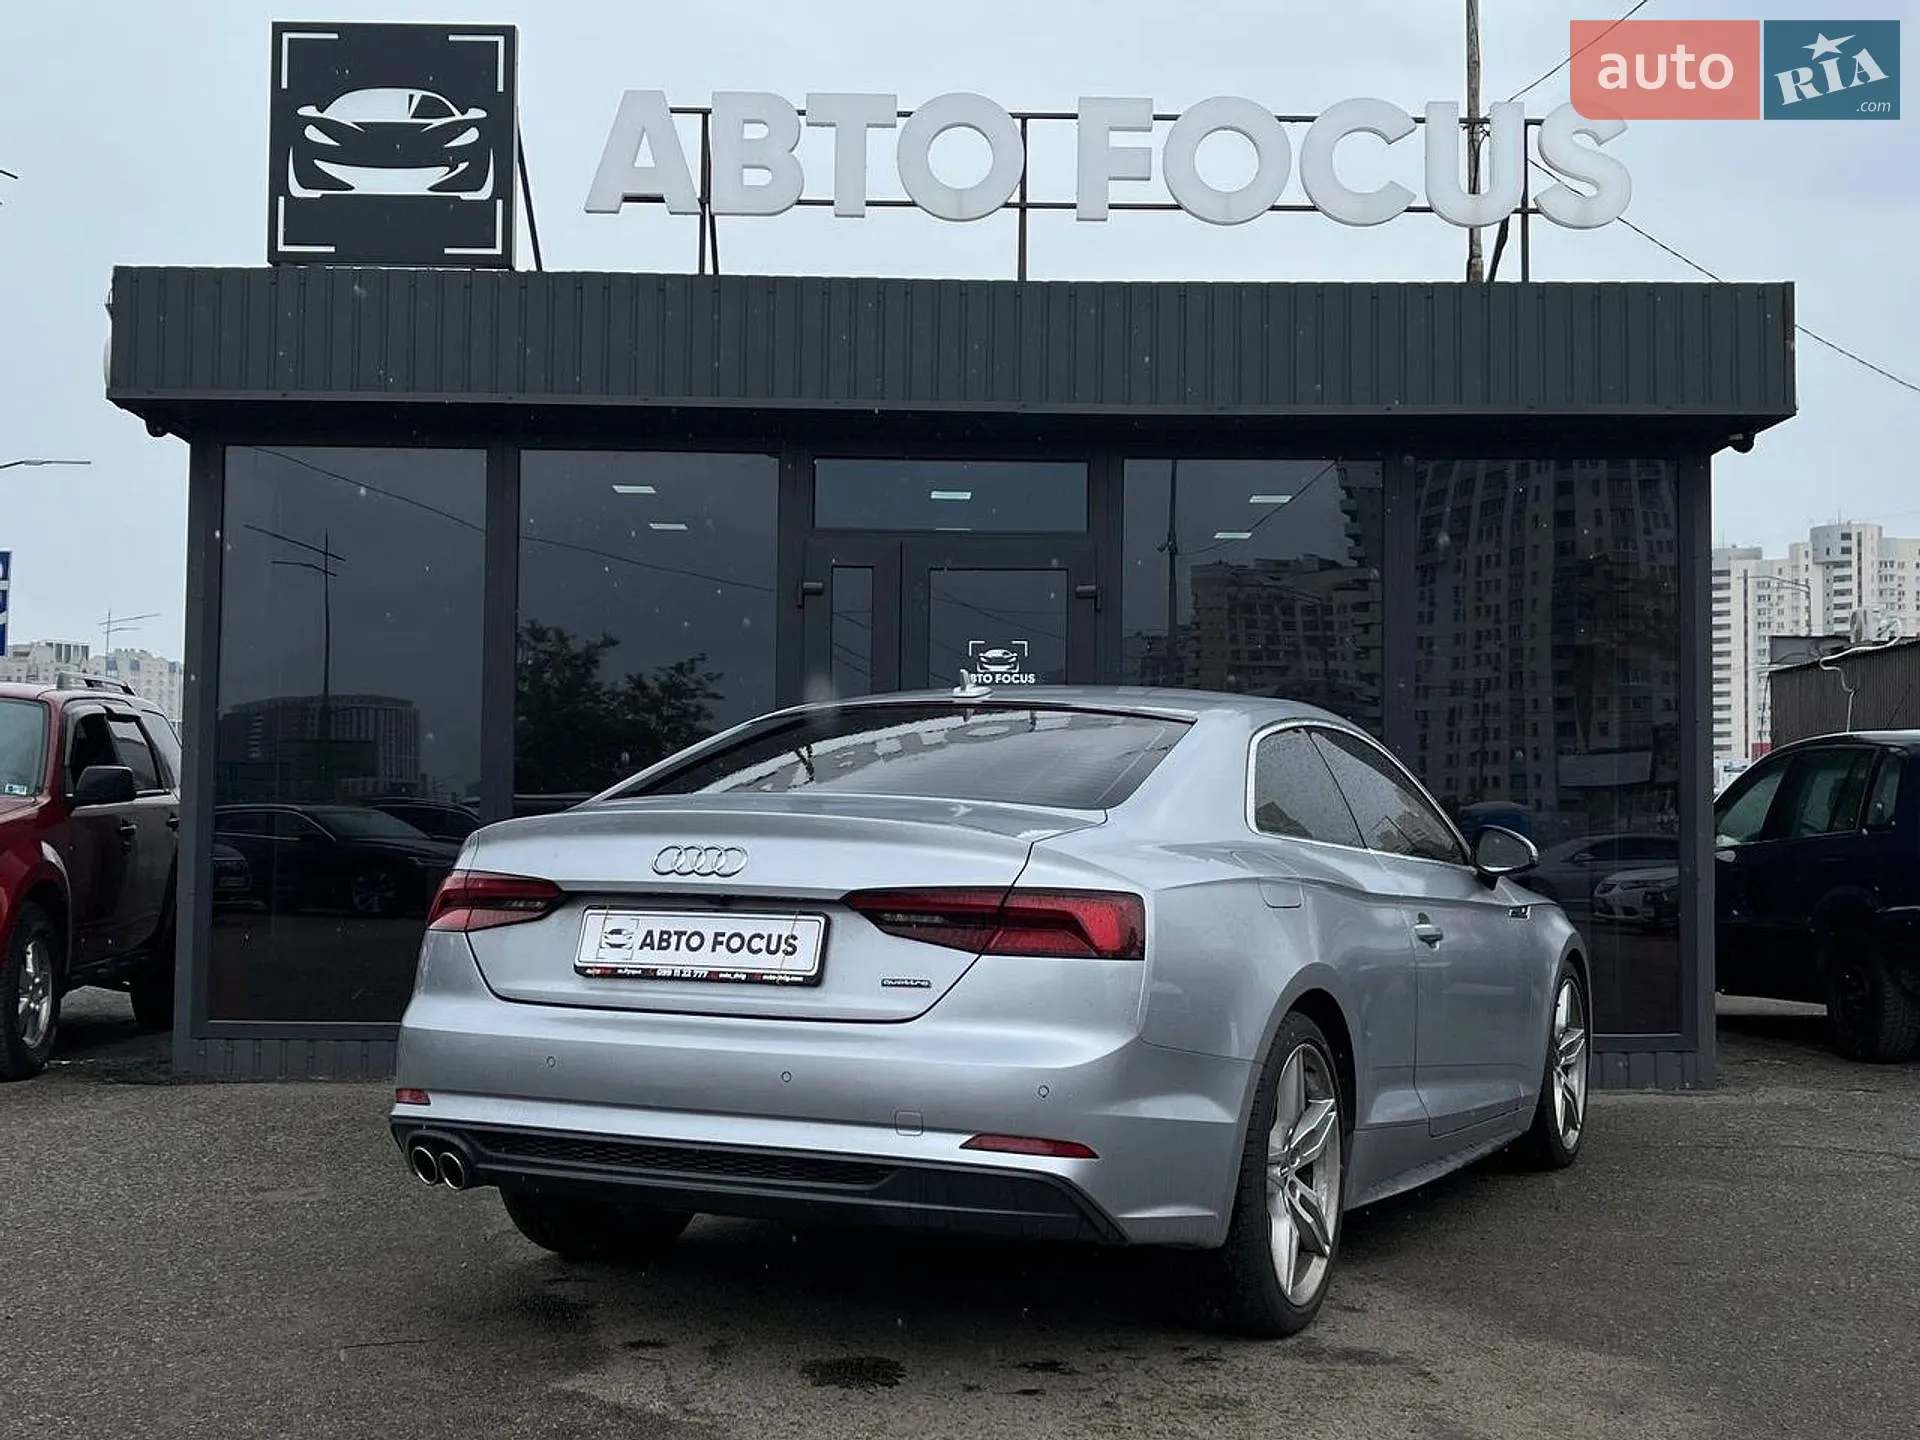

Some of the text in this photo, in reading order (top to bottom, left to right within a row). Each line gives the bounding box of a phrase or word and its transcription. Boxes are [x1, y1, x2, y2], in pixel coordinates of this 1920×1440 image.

[585, 90, 1634, 230] АВТО FOCUS
[994, 673, 1036, 684] FOCUS
[638, 928, 799, 957] АВТО FOCUS
